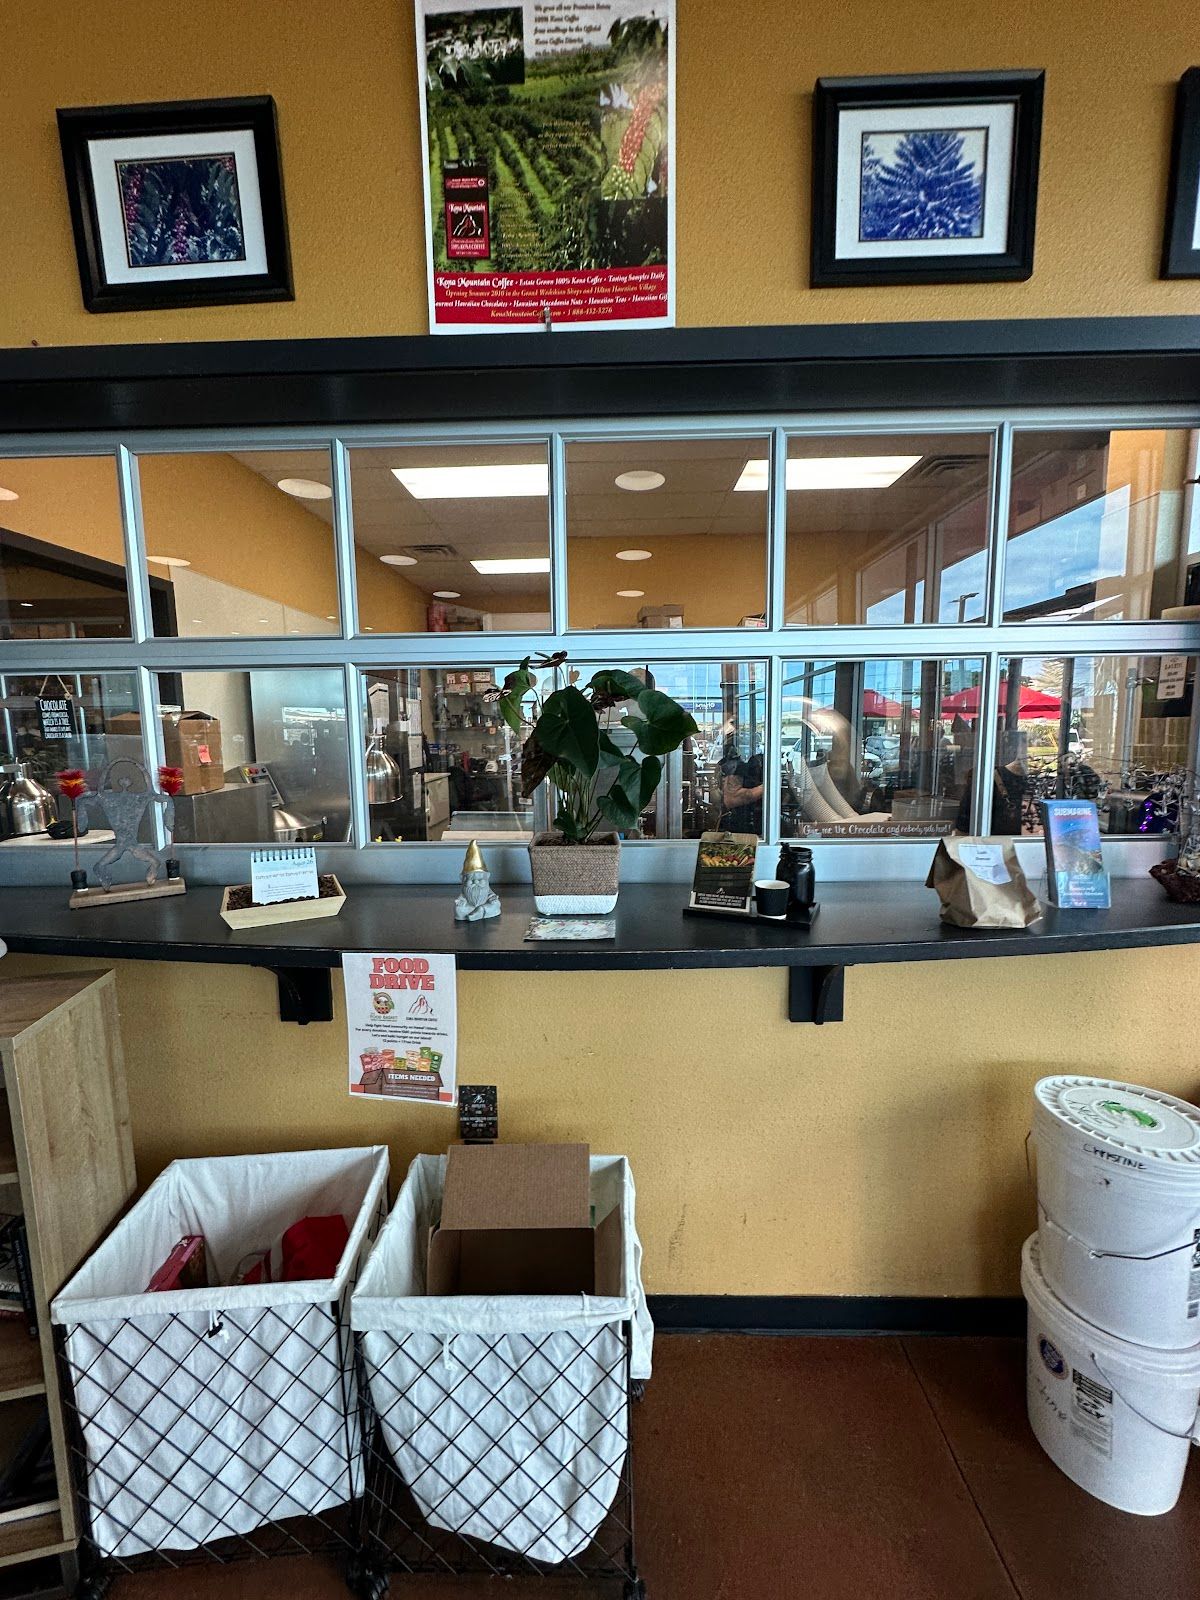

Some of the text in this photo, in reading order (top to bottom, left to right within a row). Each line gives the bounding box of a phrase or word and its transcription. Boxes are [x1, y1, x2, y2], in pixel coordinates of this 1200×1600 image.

[437, 276, 456, 289] Kona
[458, 276, 490, 288] Mountain
[492, 278, 514, 289] Coffee
[650, 272, 666, 281] Daily
[834, 825, 846, 834] the
[848, 824, 885, 834] Chocolate
[886, 824, 900, 834] and
[372, 958, 430, 974] FOOD
[369, 974, 434, 990] DRIVE
